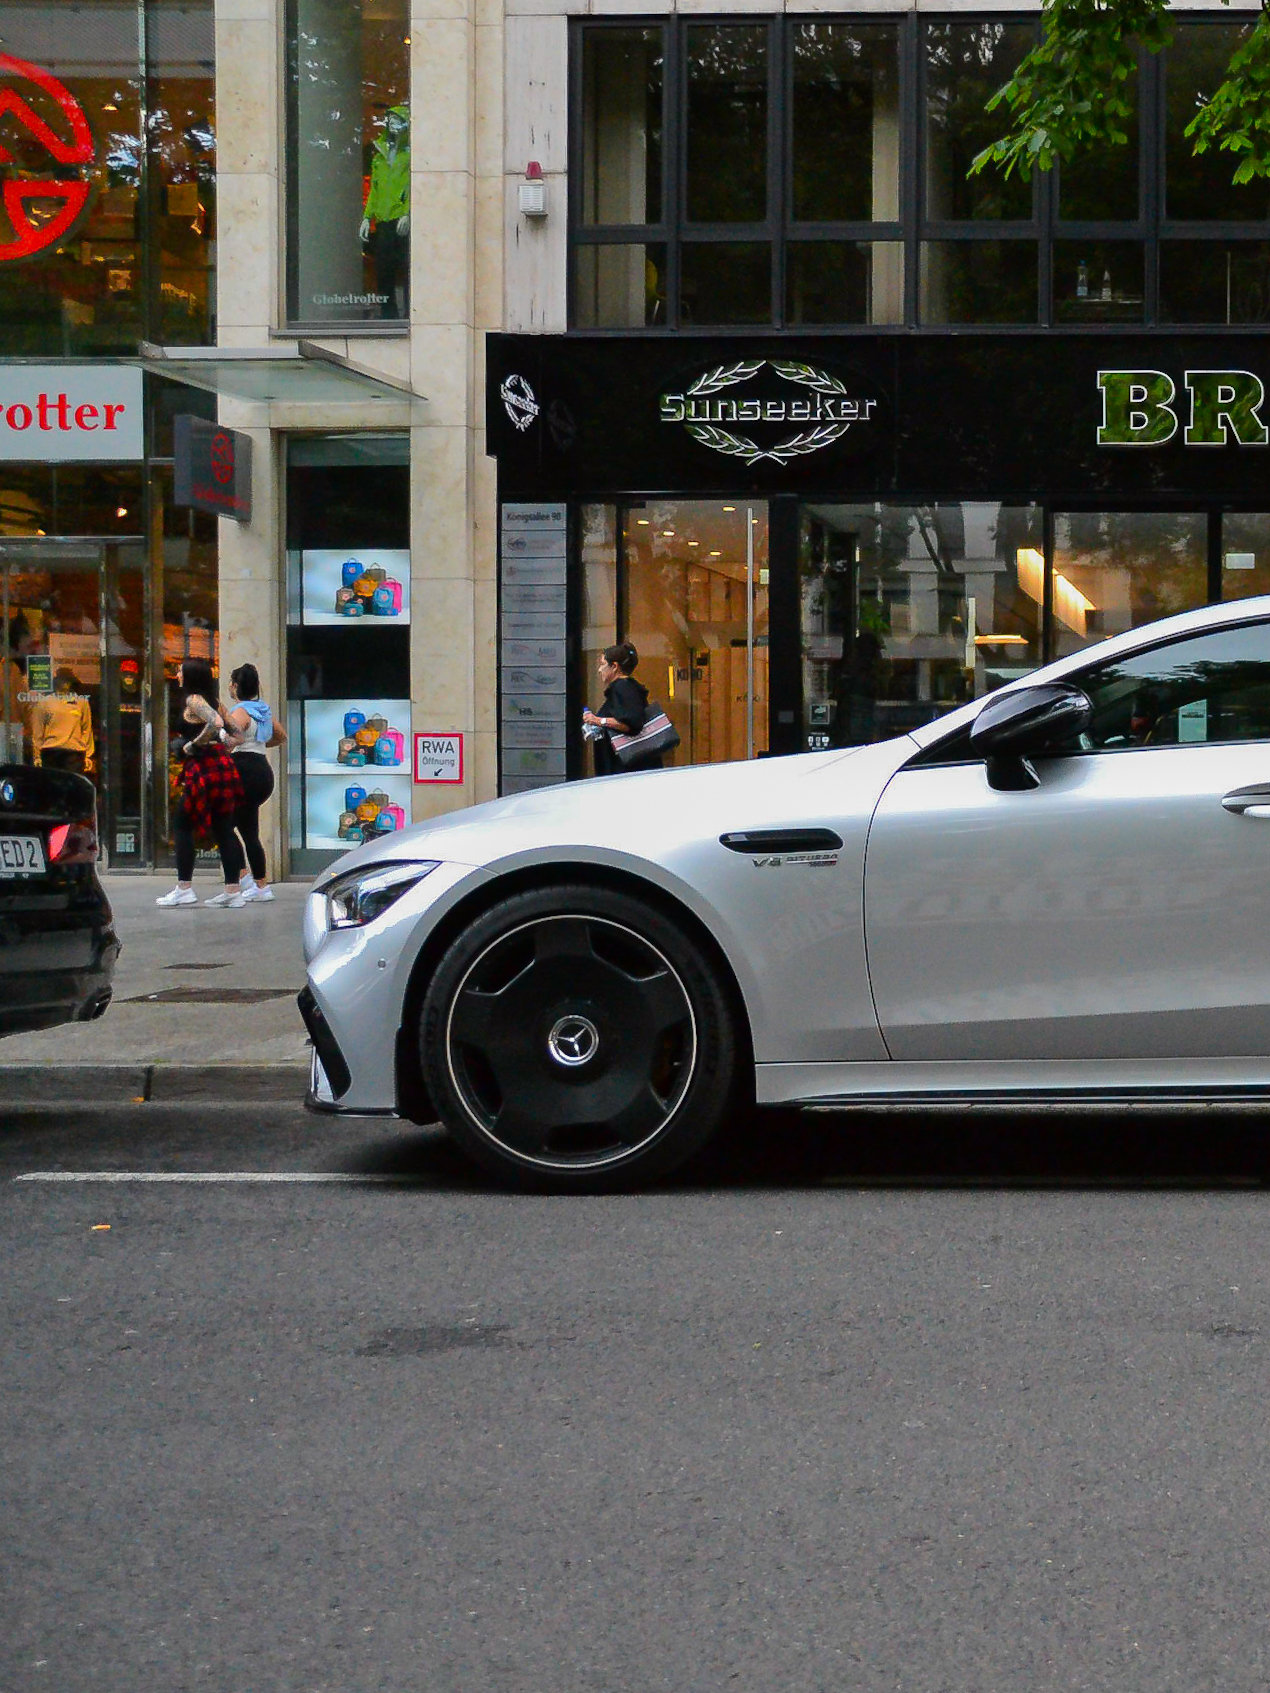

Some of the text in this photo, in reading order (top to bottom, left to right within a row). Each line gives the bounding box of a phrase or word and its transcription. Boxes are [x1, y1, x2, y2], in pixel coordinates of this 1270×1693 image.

[0, 393, 125, 431] otter
[660, 392, 878, 421] Sunseeker
[422, 740, 455, 754] RWA
[422, 756, 455, 768] Öffnung
